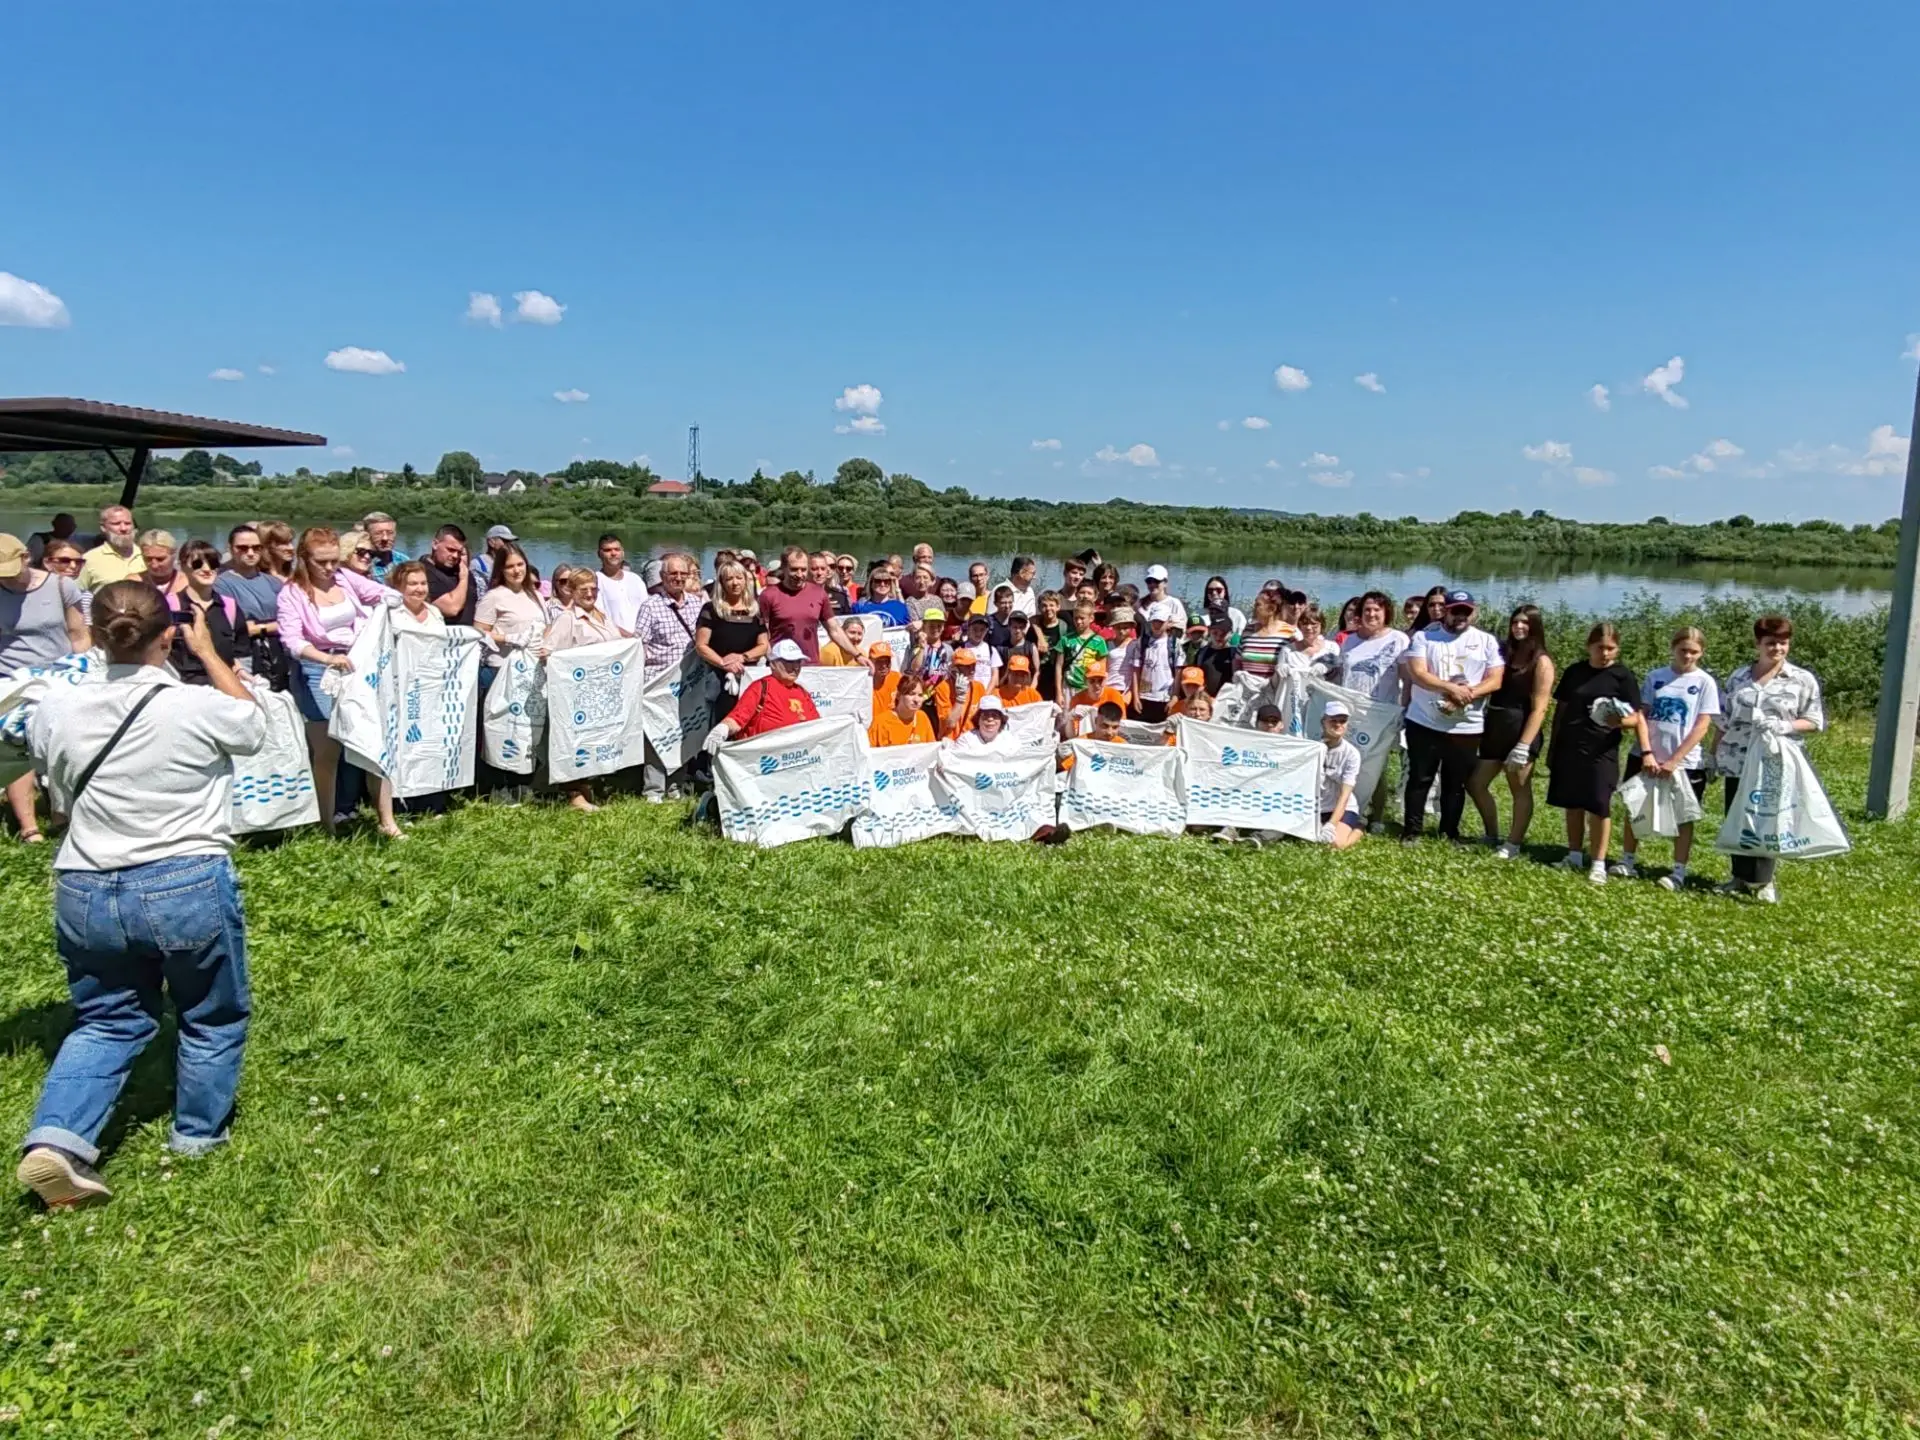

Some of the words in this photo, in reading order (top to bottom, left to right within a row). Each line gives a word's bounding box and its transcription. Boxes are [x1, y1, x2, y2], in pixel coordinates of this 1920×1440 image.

[407, 691, 415, 720] ВОДА
[781, 748, 809, 760] ВОДА
[1242, 749, 1268, 760] ВОДА
[892, 767, 916, 777] ВОДА
[994, 771, 1020, 780] ВОДА
[1764, 831, 1794, 842] ВОДА
[1765, 837, 1811, 851] РОССИИ
